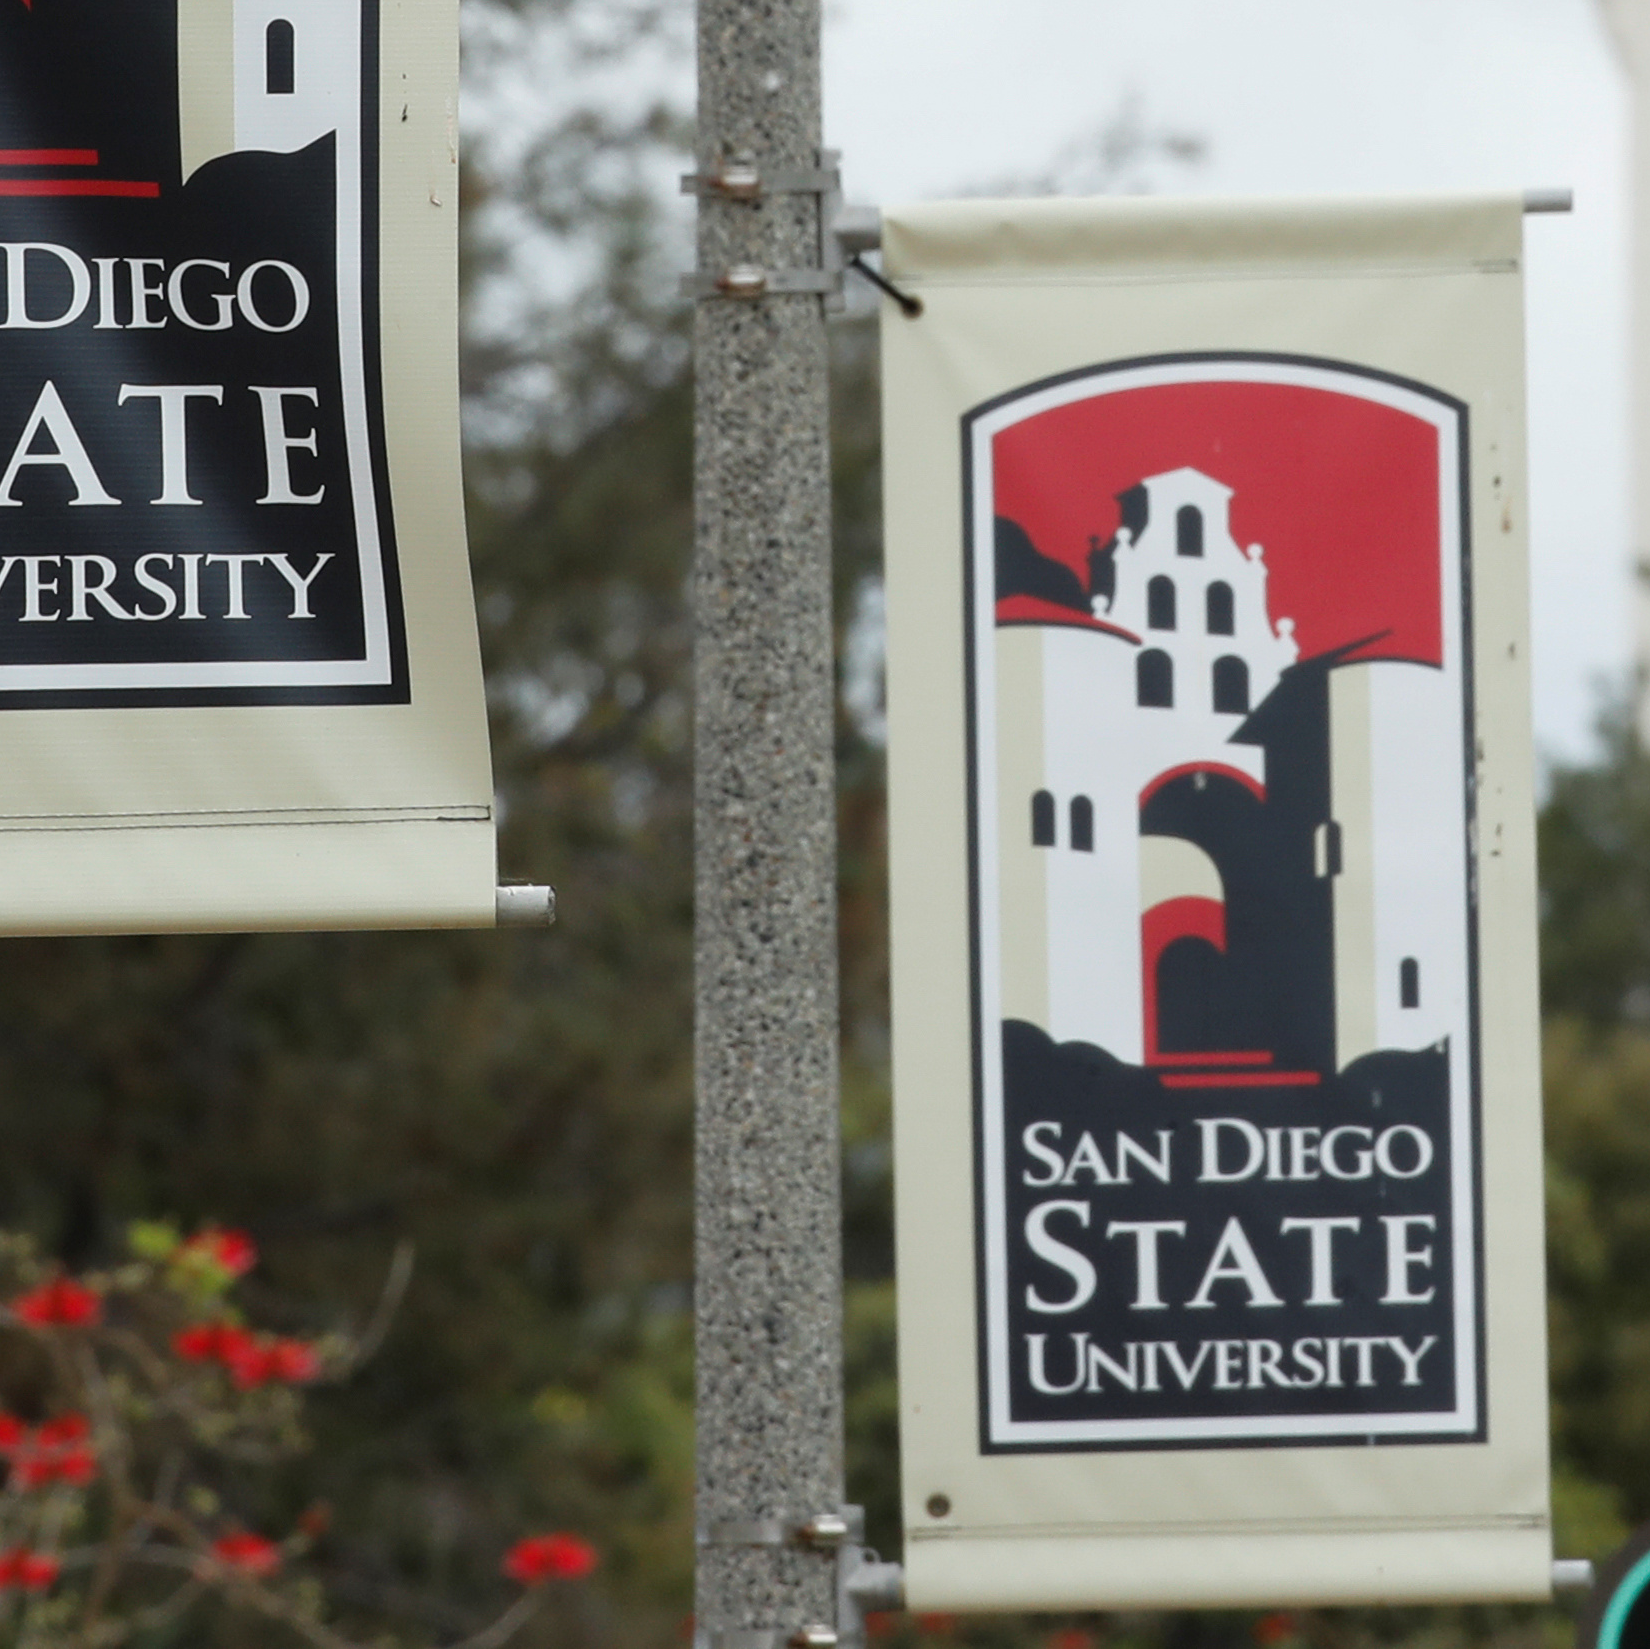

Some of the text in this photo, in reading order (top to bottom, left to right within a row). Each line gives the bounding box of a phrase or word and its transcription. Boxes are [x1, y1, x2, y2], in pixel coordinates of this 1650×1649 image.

[1022, 1117, 1433, 1187] SAN DIEGO
[1024, 1199, 1437, 1314] STATE
[1025, 1333, 1437, 1395] UNIVERSITY
